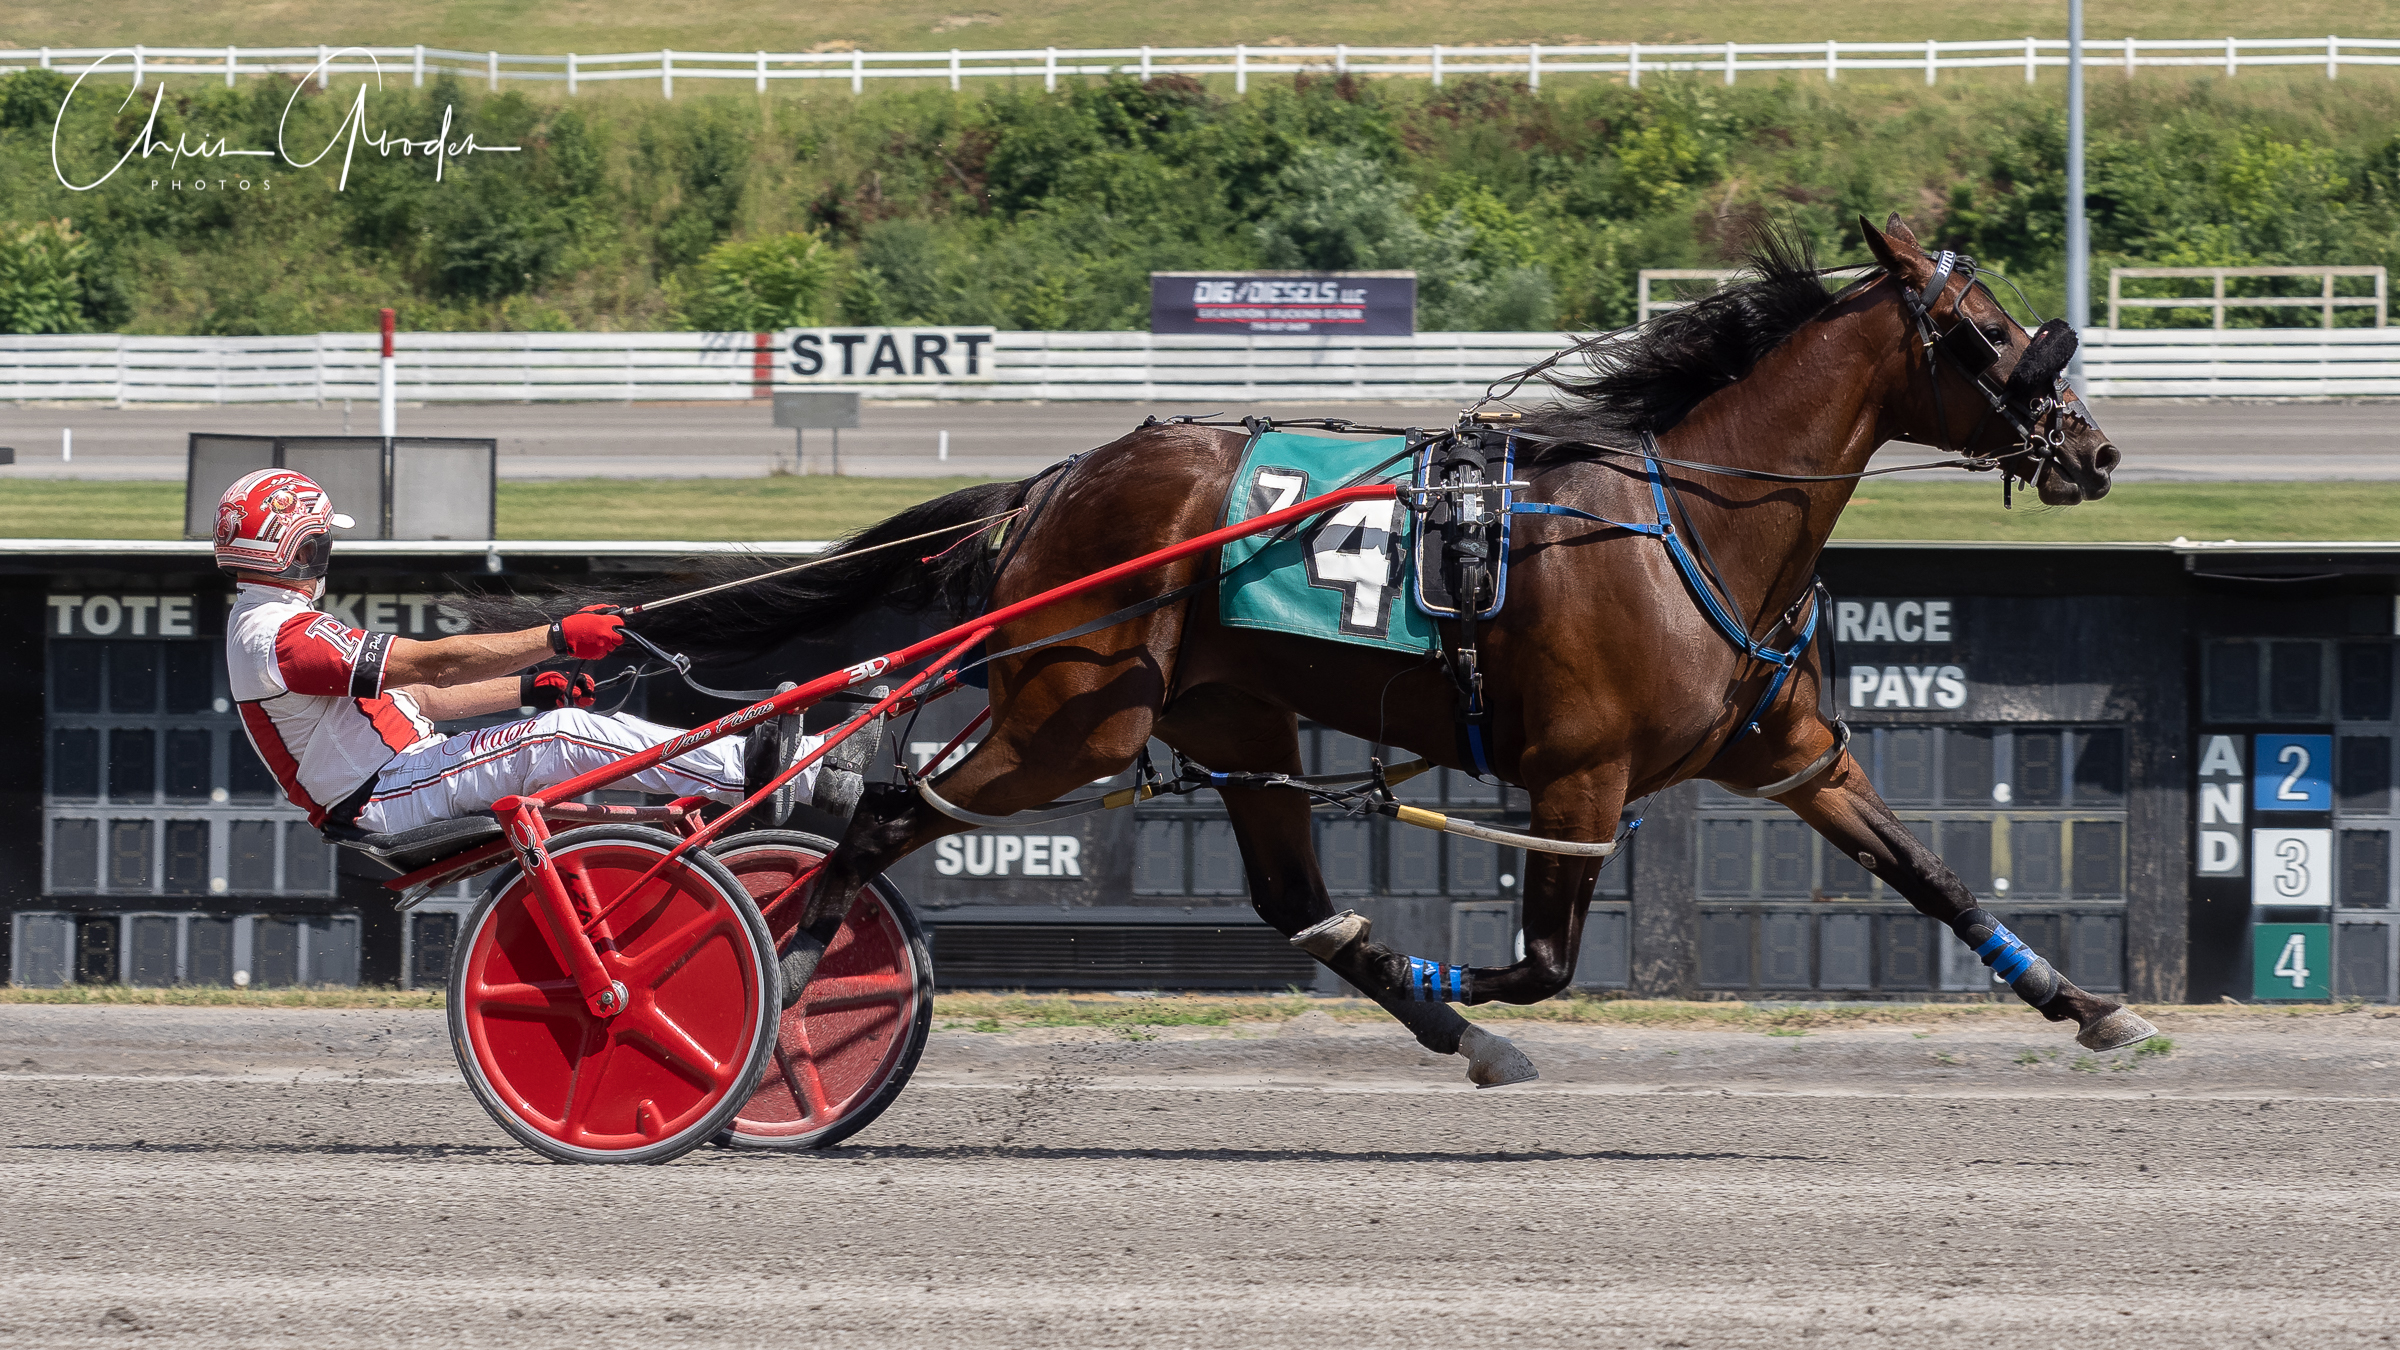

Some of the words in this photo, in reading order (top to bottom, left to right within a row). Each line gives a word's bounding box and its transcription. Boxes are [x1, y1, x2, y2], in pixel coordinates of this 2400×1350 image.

[792, 334, 992, 375] START
[1256, 471, 1304, 534] 7
[1309, 492, 1400, 631] 4
[46, 595, 194, 635] TOTE
[1836, 601, 1952, 642] RACE
[1850, 665, 1967, 708] PAYS
[659, 729, 711, 760] Dave
[715, 702, 774, 734] Palone
[2277, 745, 2311, 801] 2
[2198, 735, 2244, 872] AND
[935, 834, 1082, 876] SUPER
[2273, 838, 2311, 897] 3
[2273, 933, 2311, 988] 4
